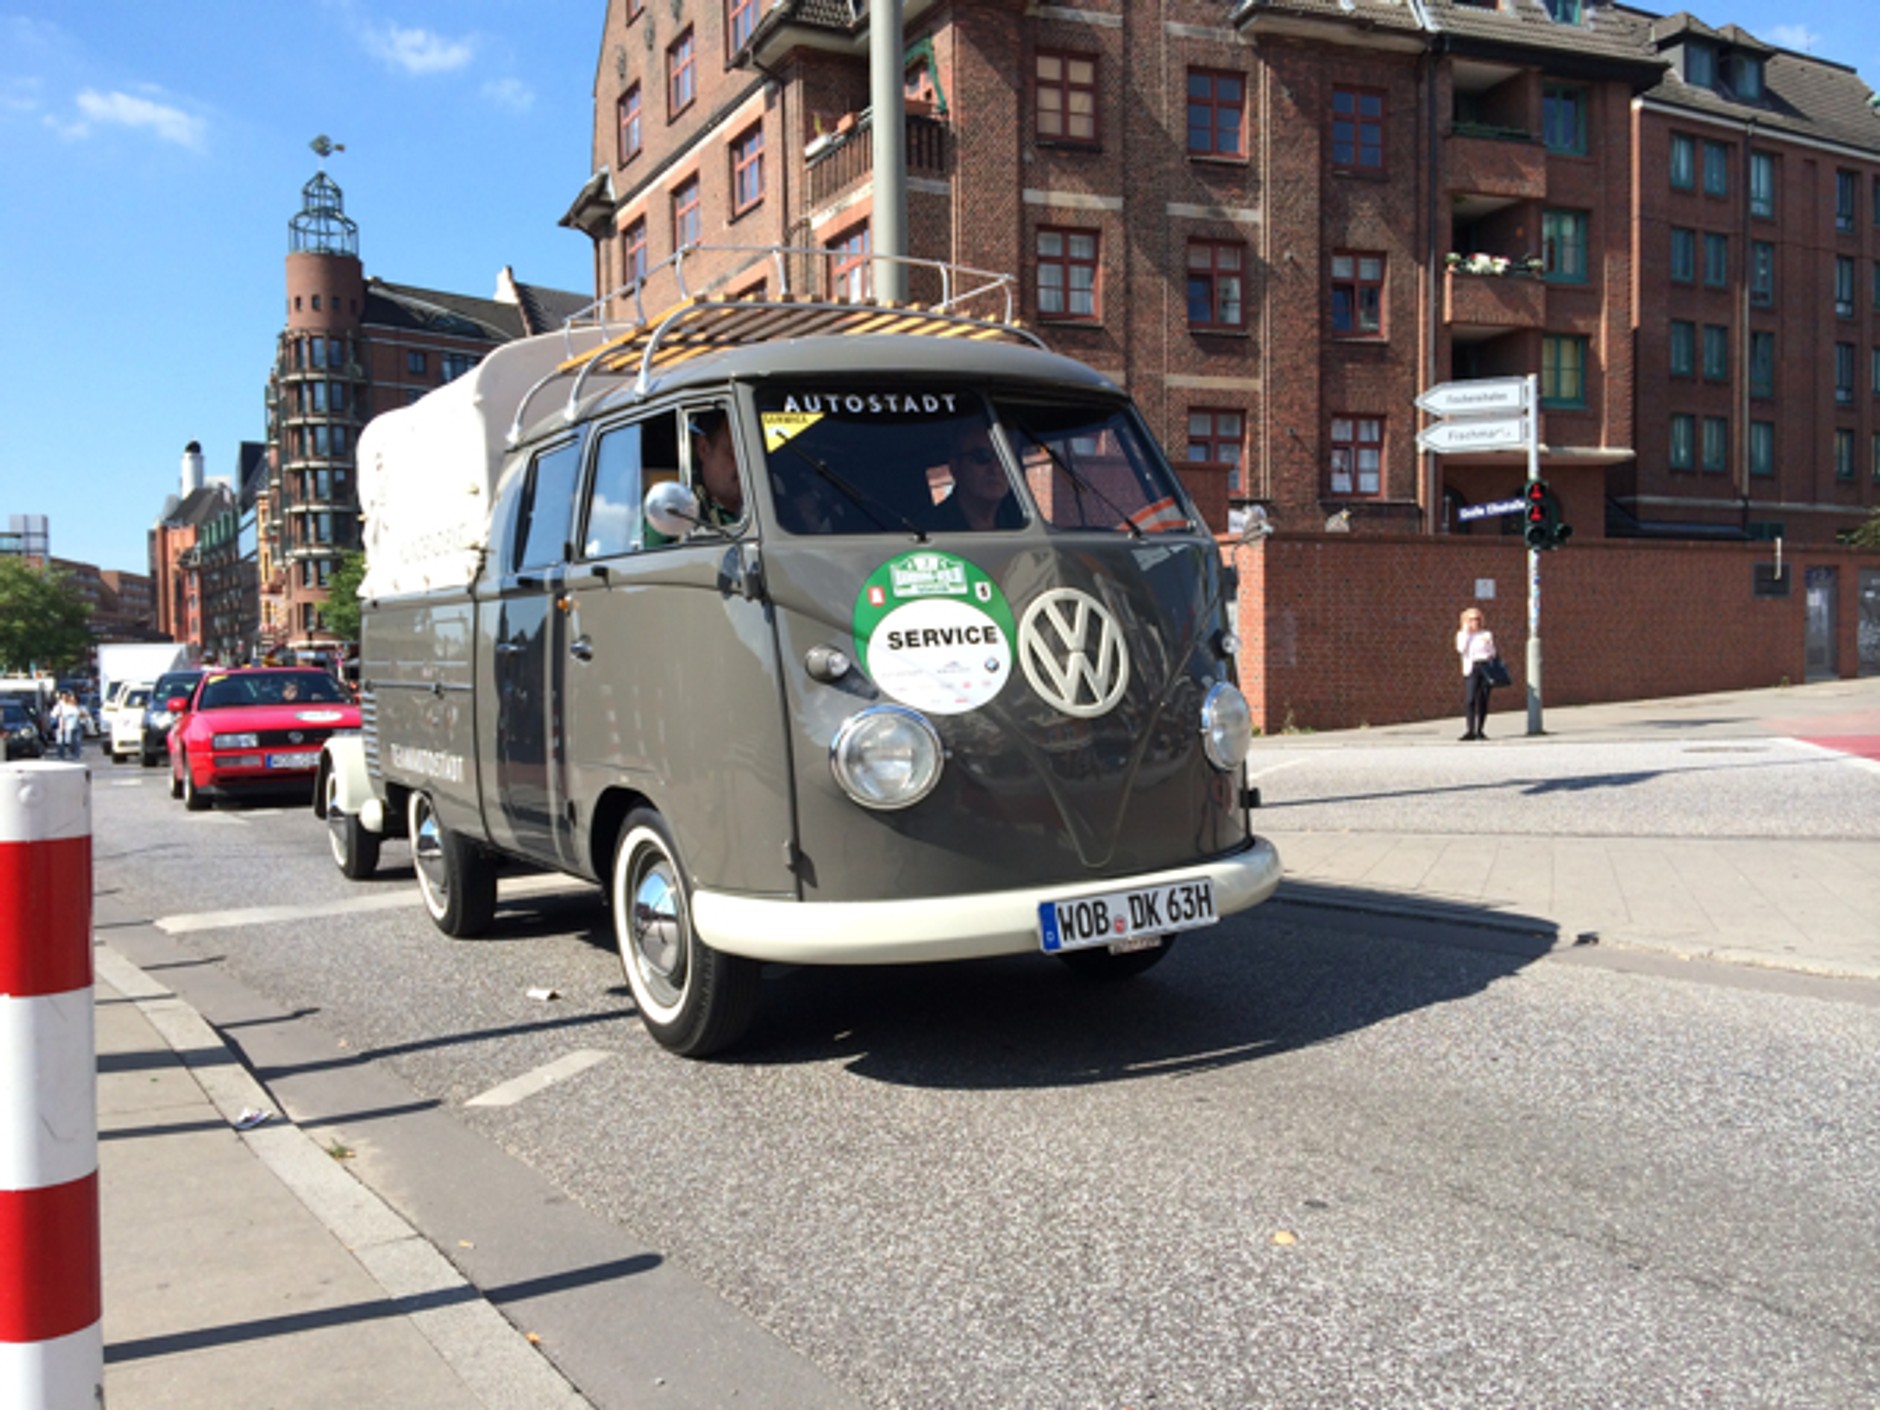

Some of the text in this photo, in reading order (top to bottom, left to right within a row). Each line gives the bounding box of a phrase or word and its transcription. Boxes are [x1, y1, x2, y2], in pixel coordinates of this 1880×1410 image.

[784, 394, 956, 413] AUTOSTADT
[887, 626, 998, 650] SERVICE
[1057, 883, 1212, 941] WOB DK 63H
